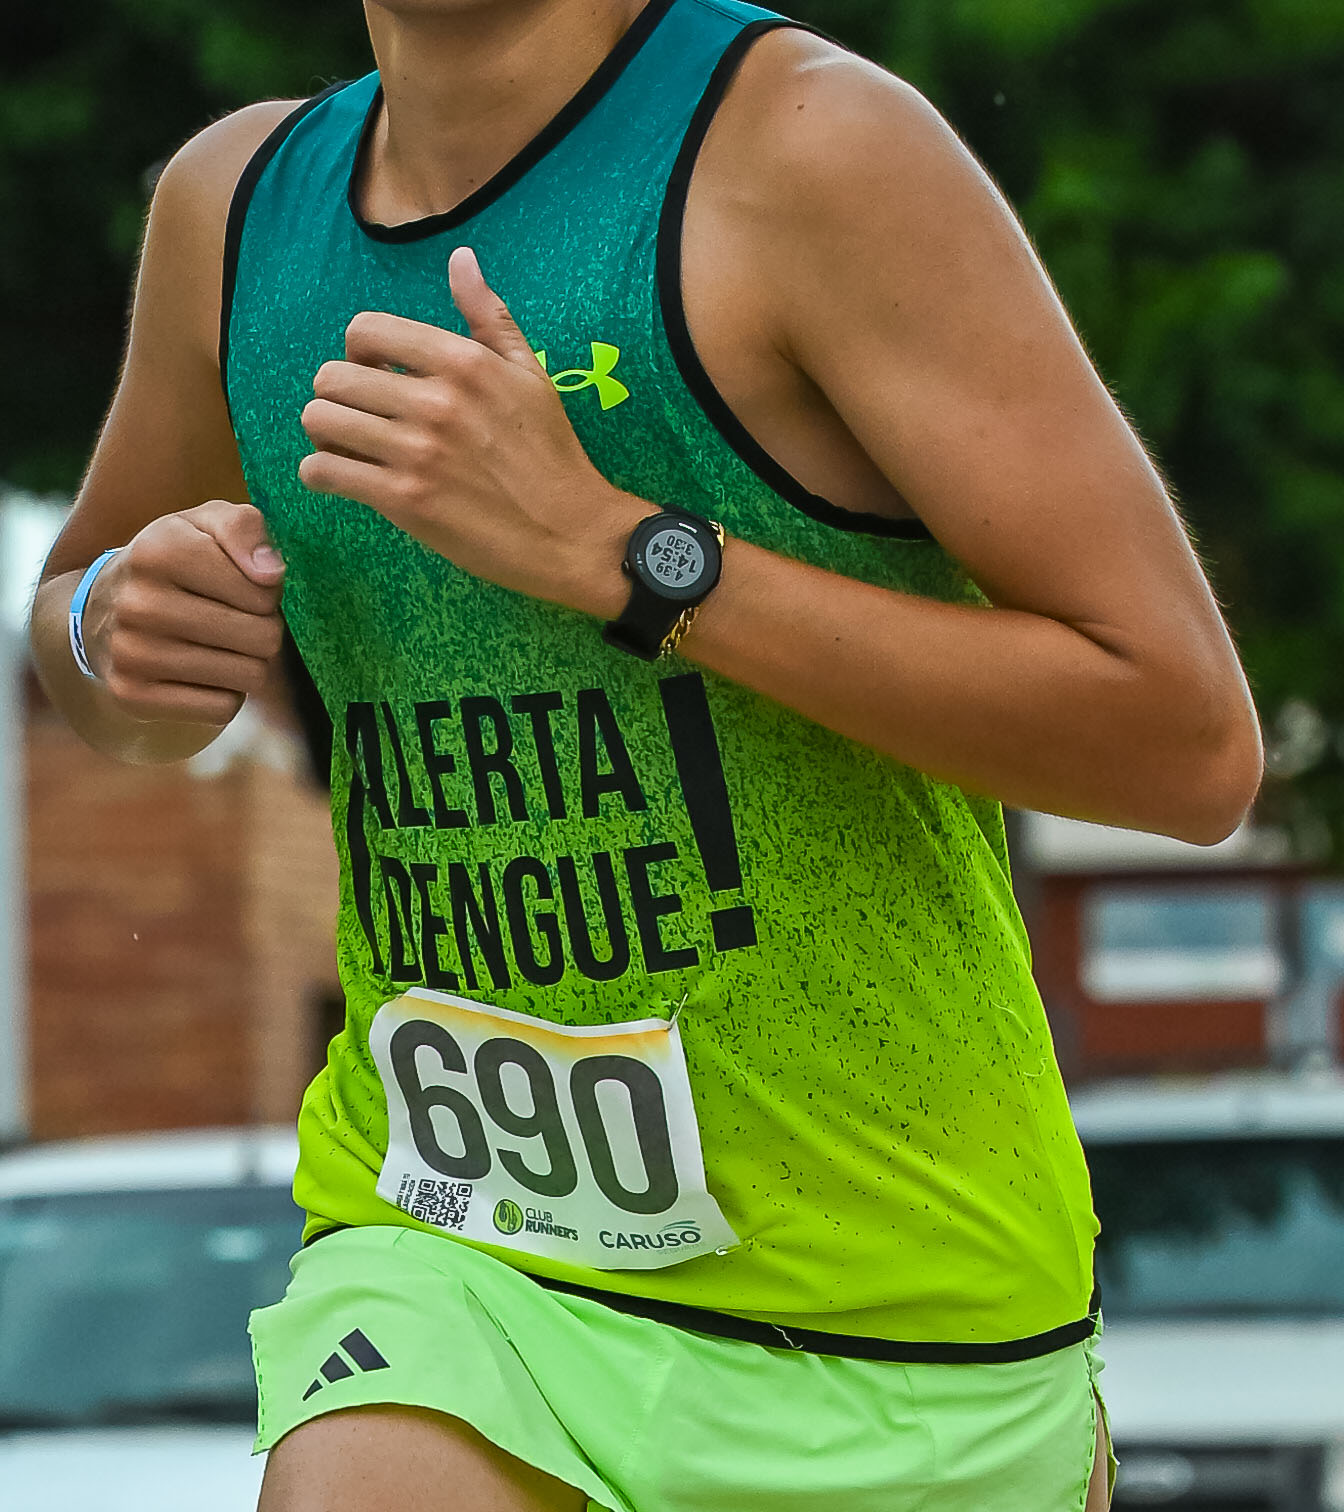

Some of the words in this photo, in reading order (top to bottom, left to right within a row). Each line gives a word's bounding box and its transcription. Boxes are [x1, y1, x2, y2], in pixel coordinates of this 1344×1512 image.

[650, 542, 697, 573] 14:54
[390, 1019, 679, 1215] 690
[526, 1207, 553, 1222] CLUB
[599, 1230, 701, 1250] CARUSO
